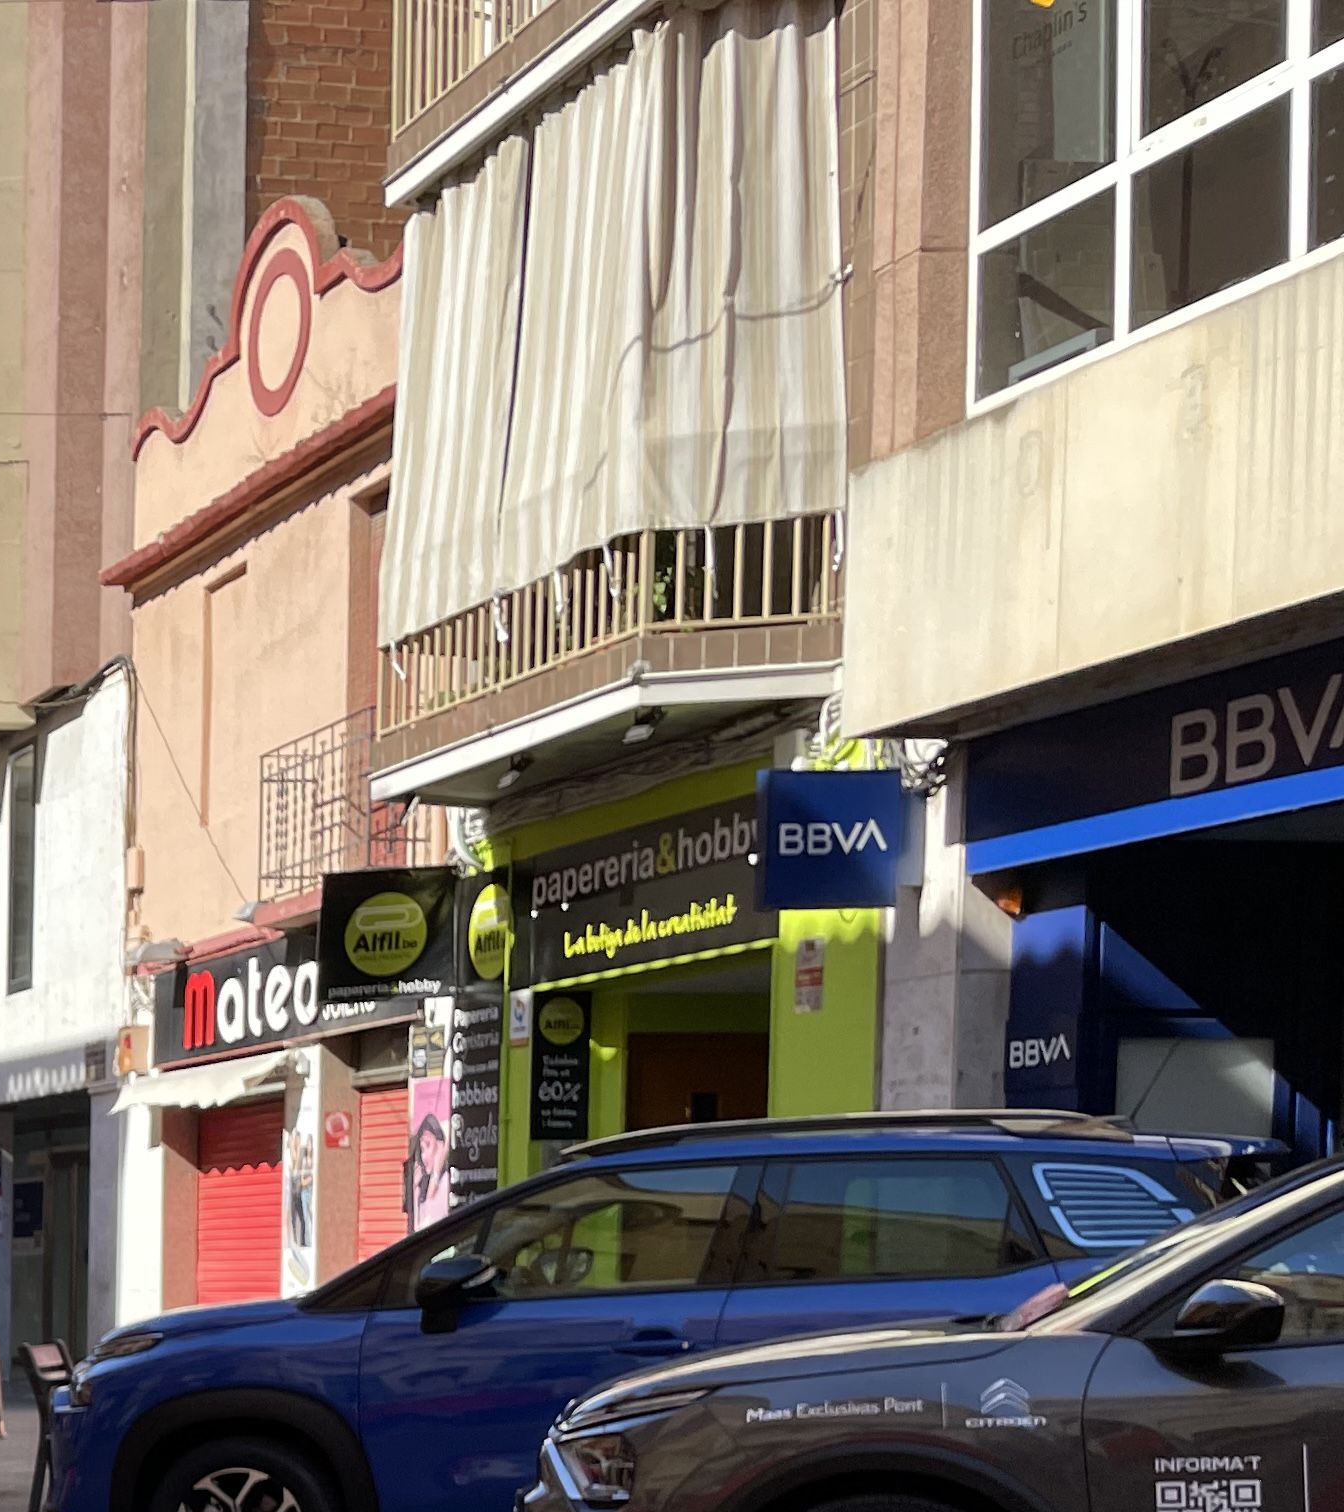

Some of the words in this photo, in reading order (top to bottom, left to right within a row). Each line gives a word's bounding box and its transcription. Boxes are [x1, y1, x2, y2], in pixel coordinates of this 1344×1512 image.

[1169, 674, 1344, 797] BBV
[778, 818, 889, 857] BBVA
[1008, 1033, 1072, 1070] BBVA
[1154, 1455, 1263, 1474] INFORMA'T
